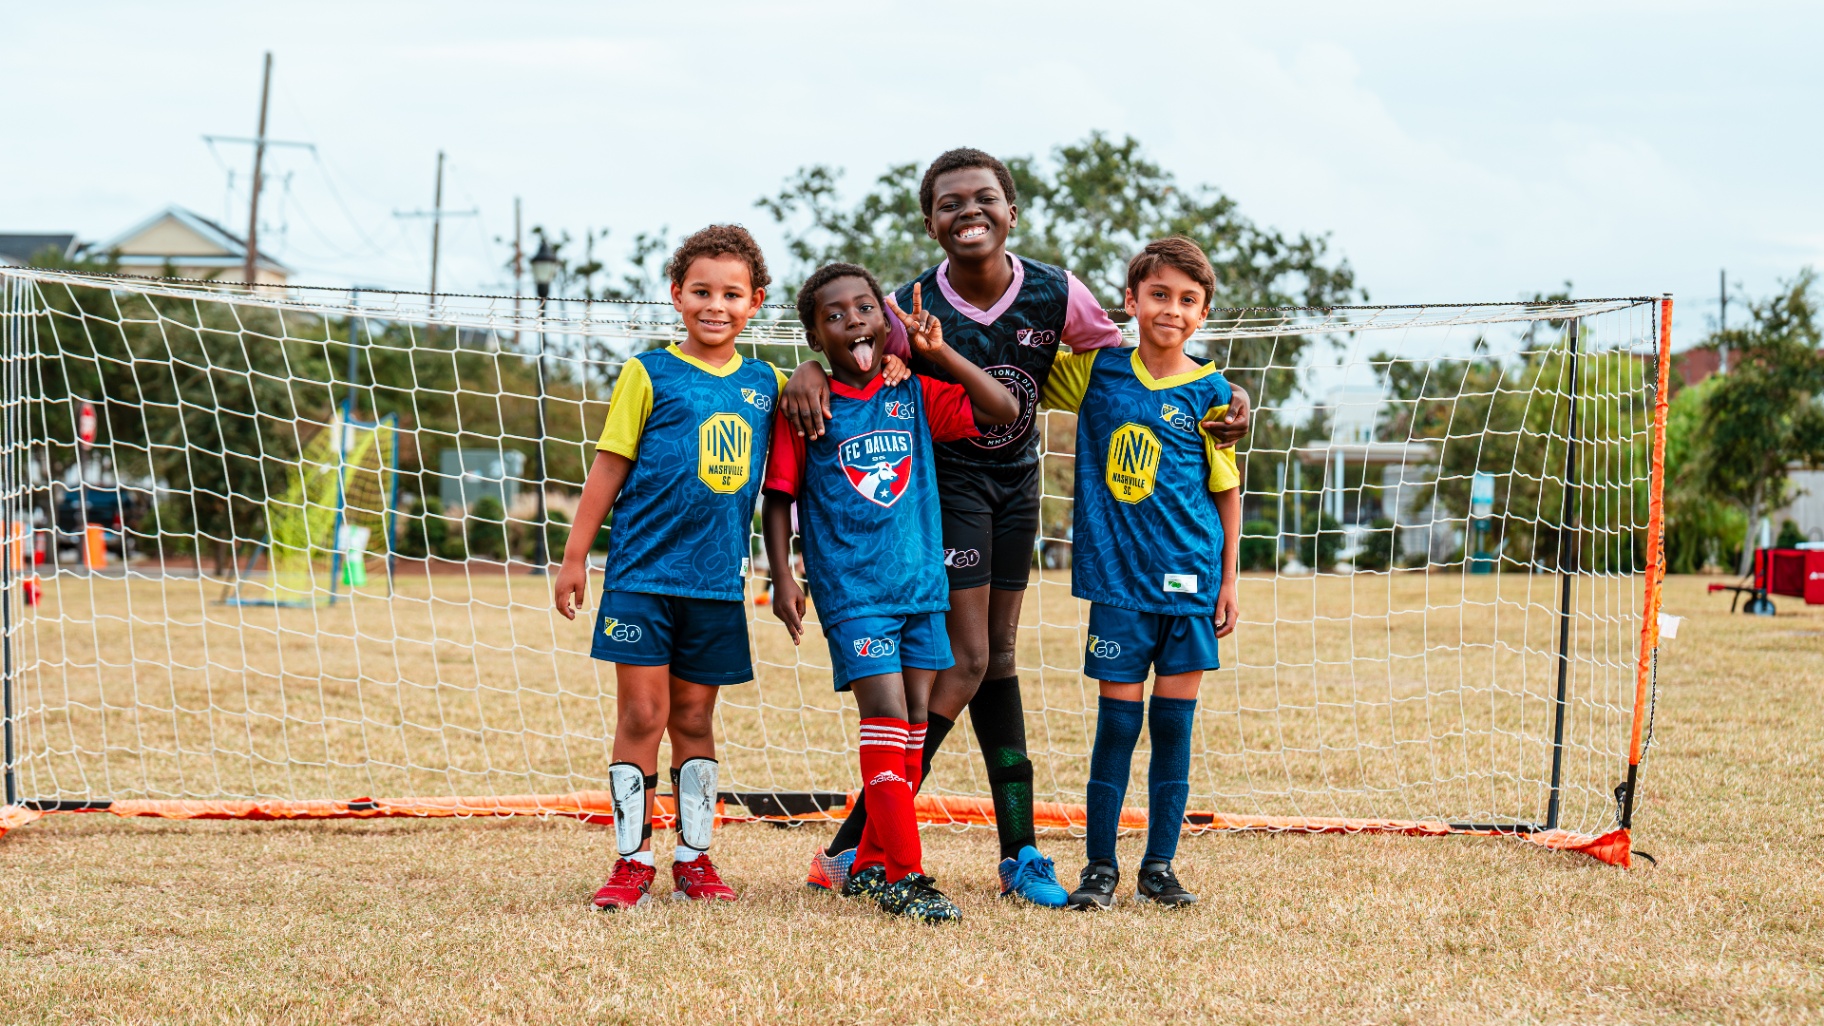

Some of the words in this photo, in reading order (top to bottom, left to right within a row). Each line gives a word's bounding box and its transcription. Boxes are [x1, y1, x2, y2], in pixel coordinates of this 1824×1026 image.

[1030, 329, 1055, 348] GO
[988, 369, 1020, 380] CIONAL
[1022, 378, 1032, 388] DE
[753, 393, 771, 412] GO
[1170, 412, 1195, 433] GO
[845, 442, 860, 462] FC
[864, 435, 908, 454] DALLAS
[988, 433, 1013, 446] MMXX
[708, 464, 743, 476] NASHVILLE
[722, 475, 731, 486] SC
[1112, 472, 1145, 489] NASHVILLE
[1123, 485, 1132, 496] SC
[951, 548, 980, 568] GO
[611, 623, 642, 643] GO
[867, 637, 894, 658] GO
[1094, 639, 1120, 660] GO
